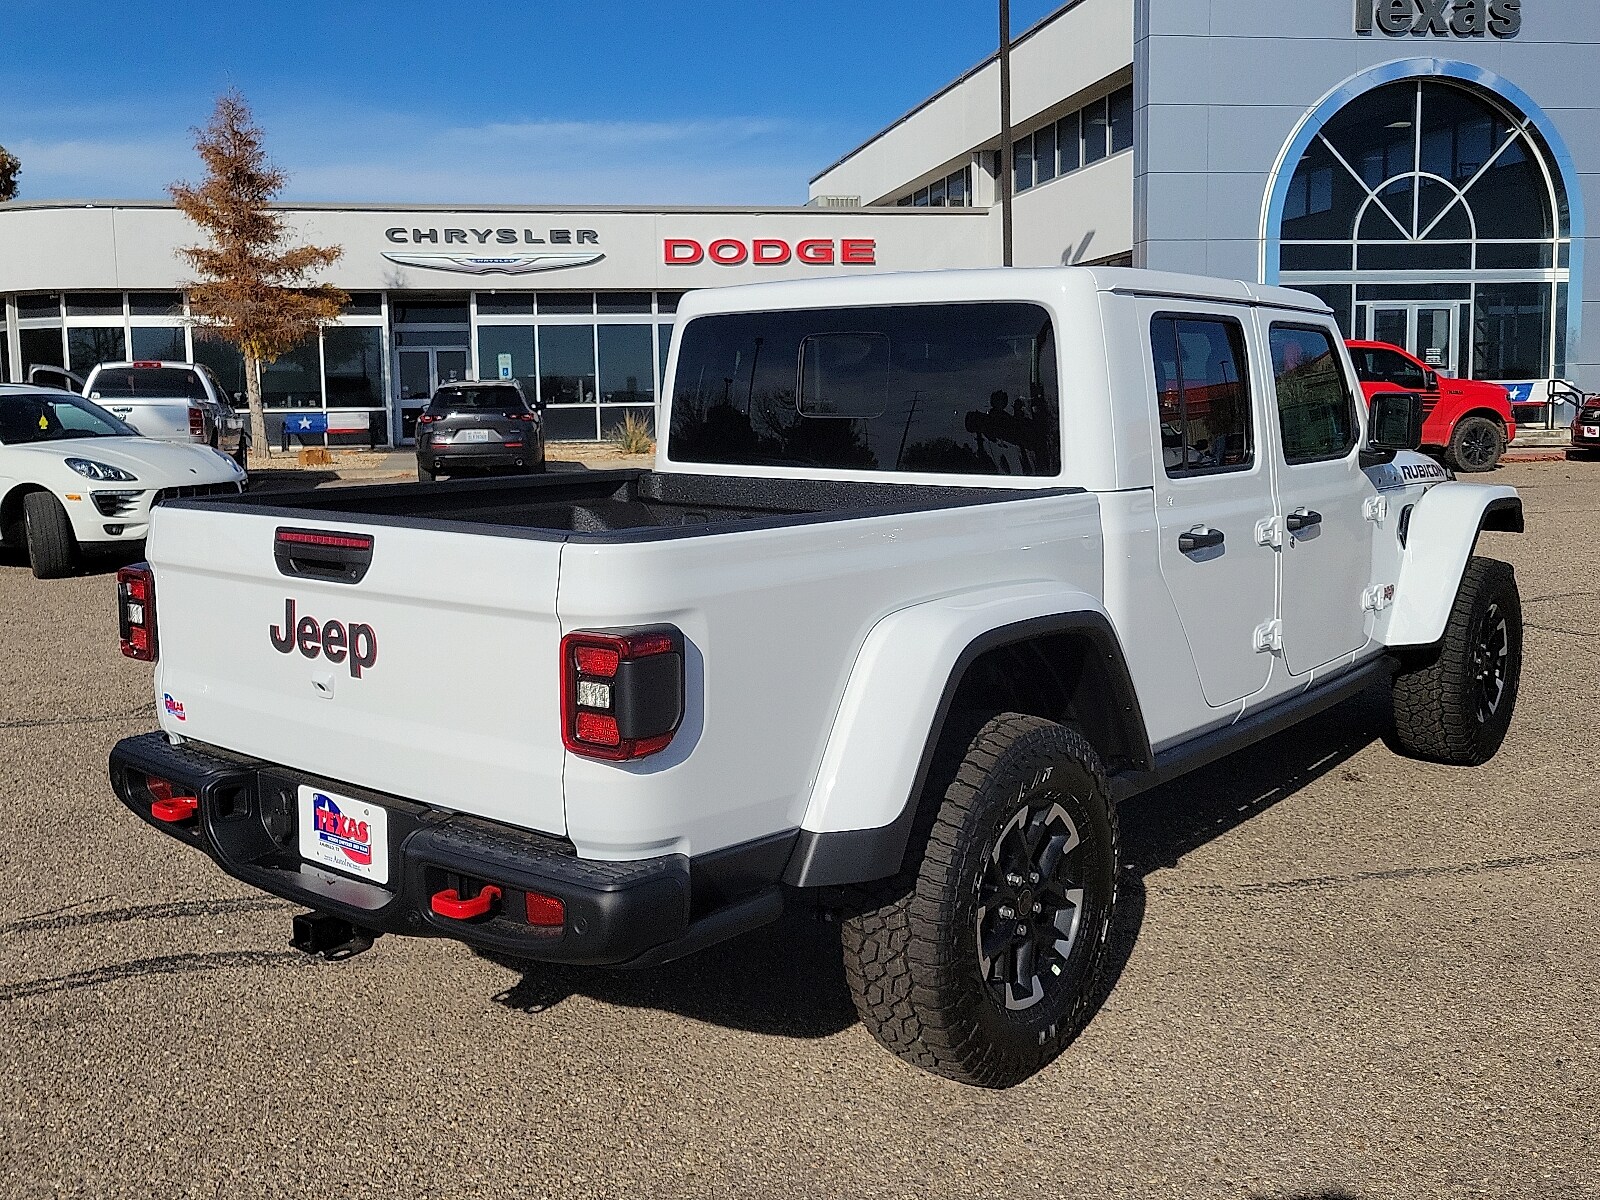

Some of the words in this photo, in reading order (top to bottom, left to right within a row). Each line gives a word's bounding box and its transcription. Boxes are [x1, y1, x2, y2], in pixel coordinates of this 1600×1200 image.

[385, 227, 600, 245] CHRYSLER
[663, 238, 877, 266] DODGE
[1400, 463, 1445, 480] RUBICON
[269, 598, 378, 680] Jeep
[316, 807, 369, 844] TEXAS
